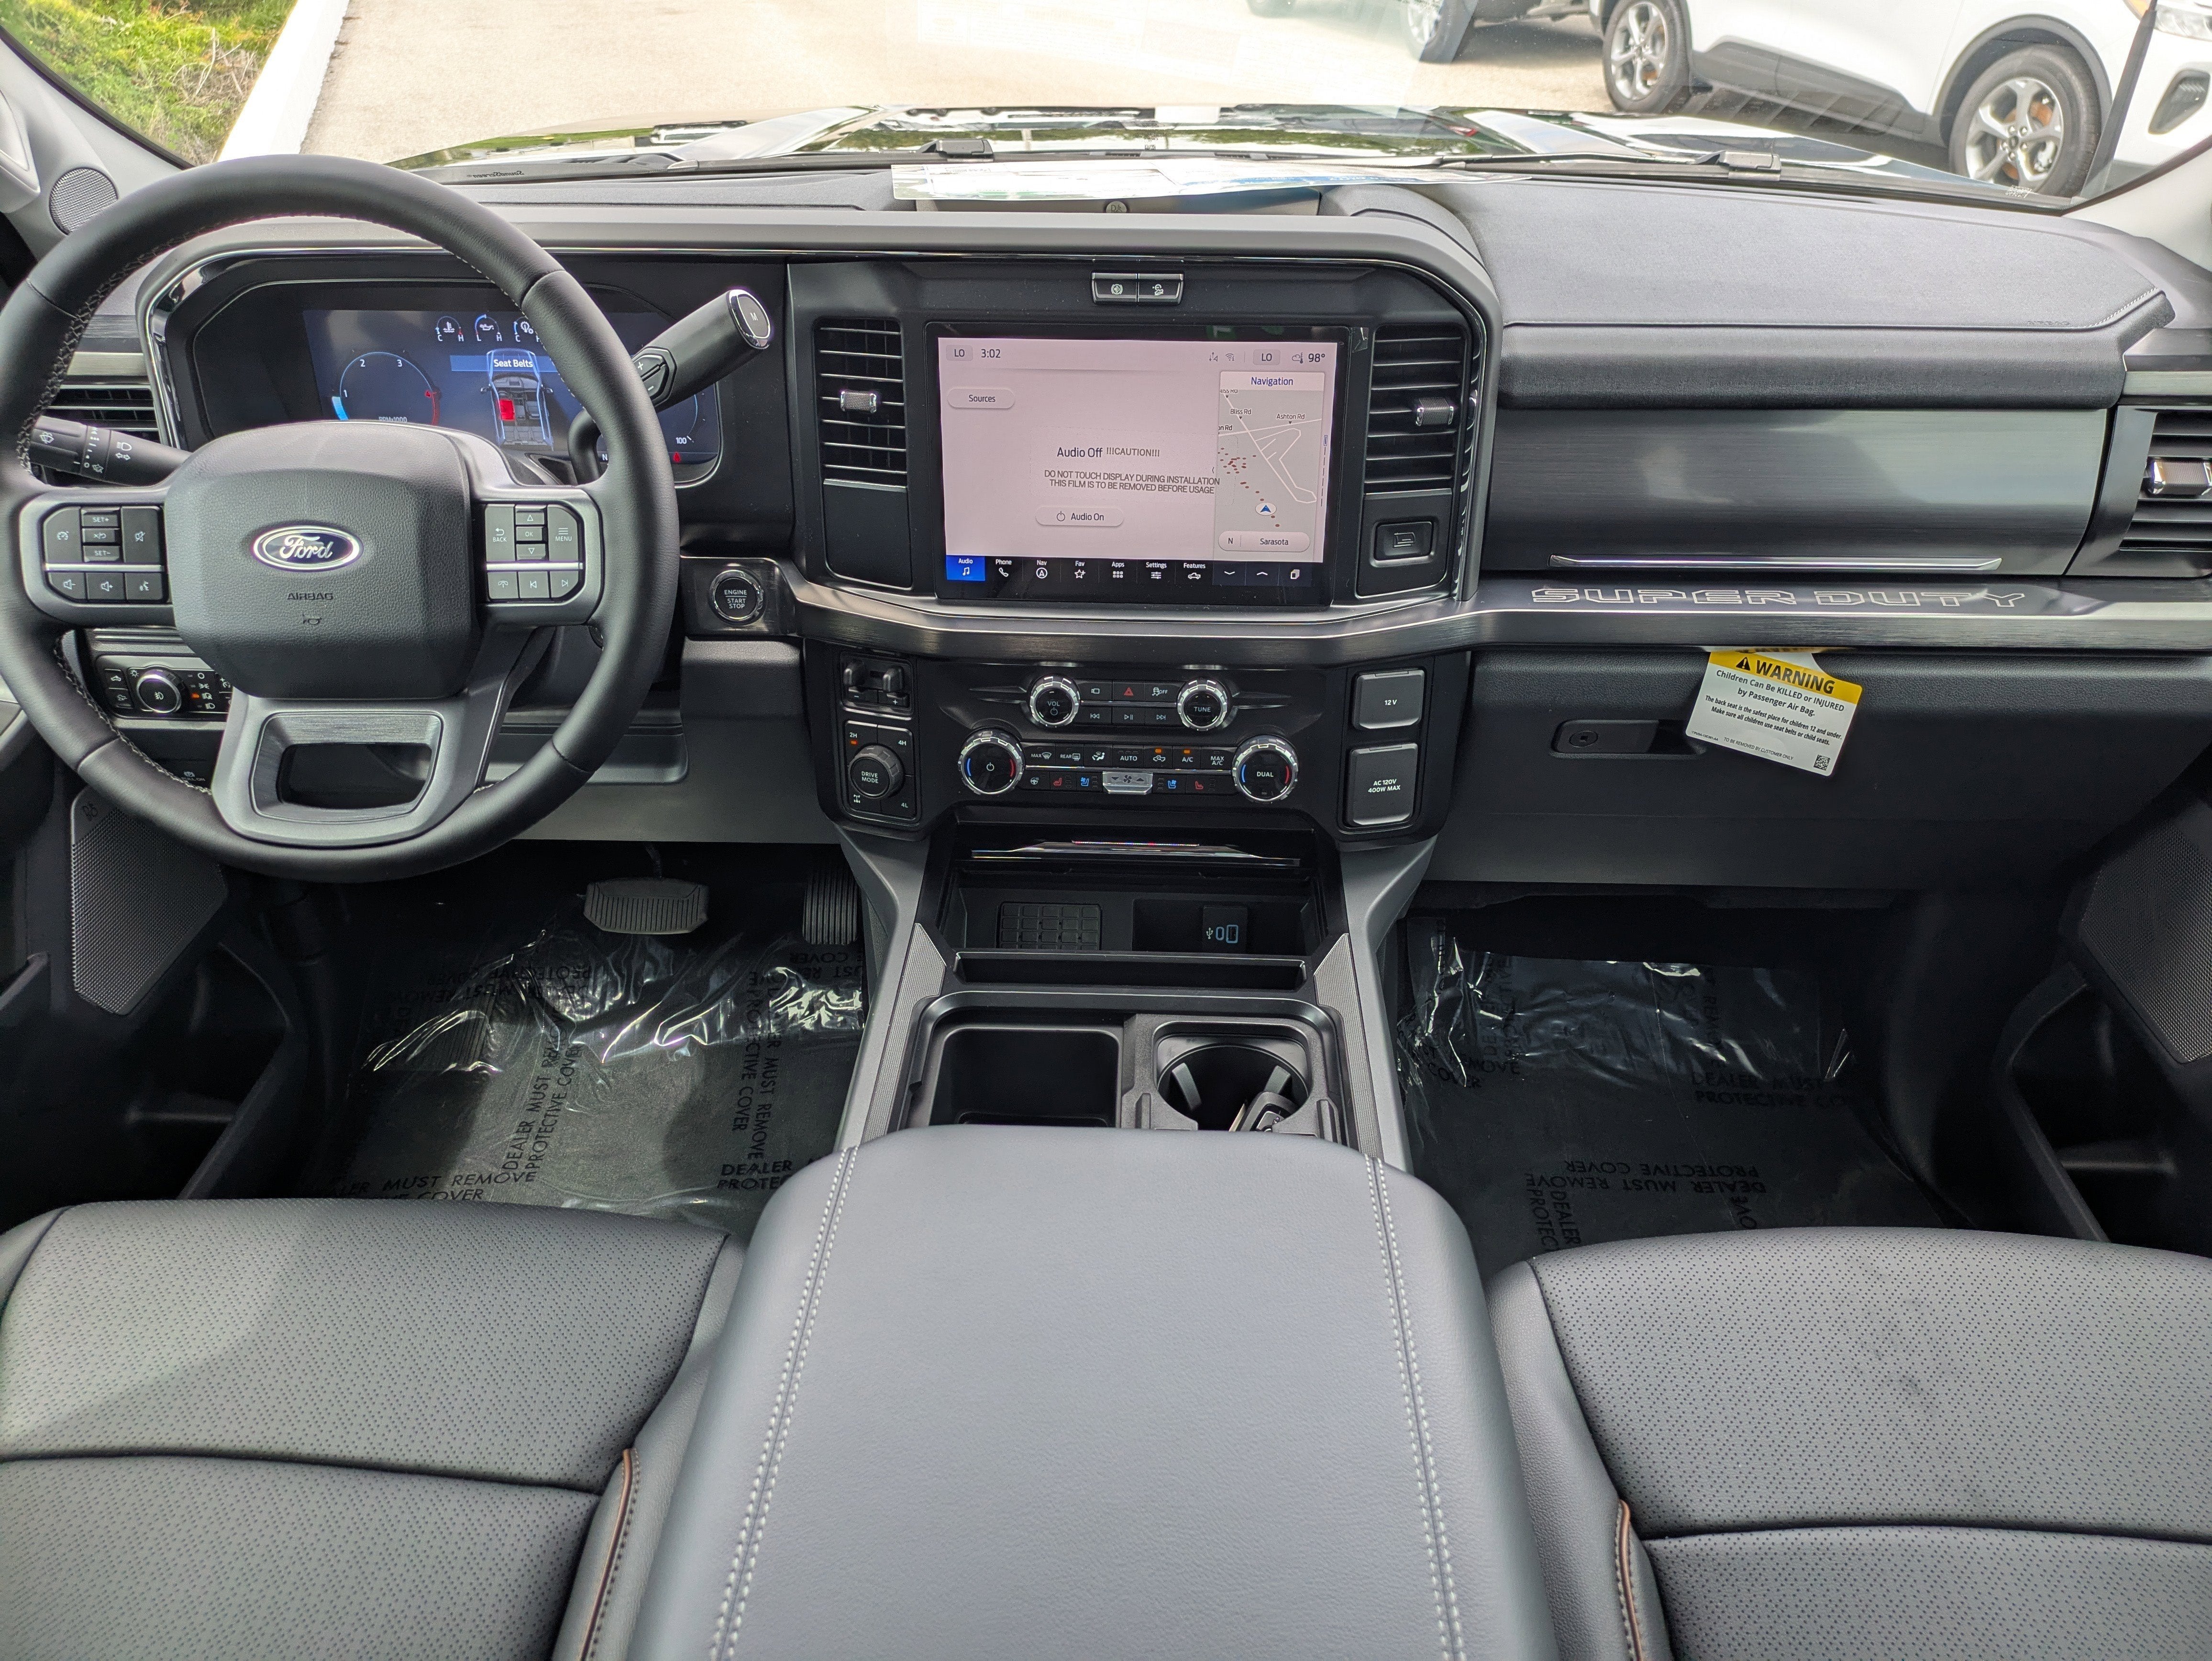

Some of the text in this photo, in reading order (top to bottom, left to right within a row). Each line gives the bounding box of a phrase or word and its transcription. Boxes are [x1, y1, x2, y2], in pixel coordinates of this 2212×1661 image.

[750, 312, 758, 321] M
[954, 349, 965, 357] LO
[981, 349, 1001, 358] 3:02
[1261, 354, 1272, 362] LO
[1308, 353, 1326, 363] 98°
[494, 359, 533, 367] Seat Belts
[1251, 377, 1294, 387] Navigation
[1057, 447, 1103, 458] Audio Off
[1106, 447, 1160, 457] !!!CAUTION!!!
[1057, 470, 1073, 478] NOT
[1074, 471, 1101, 480] TOUCH
[1103, 472, 1135, 481] DISPLAY
[1136, 474, 1165, 483] DURING
[1167, 476, 1220, 485] INSTALLATION
[1050, 479, 1066, 487] THIS
[1068, 480, 1086, 488] FILM
[1119, 482, 1156, 491] REMOVED
[1158, 484, 1188, 493] BEFORE
[1189, 486, 1215, 494] USAGE
[1071, 512, 1104, 521] Audio On
[280, 535, 334, 559] Ford
[1260, 538, 1289, 546] Sarasota
[287, 592, 333, 600] AIRBAG
[1531, 588, 2025, 608] SUPER DUTY
[1756, 660, 1835, 694] WARNING
[1716, 670, 1748, 684] Children
[1750, 679, 1764, 689] Can
[1765, 684, 1775, 692] Be
[1777, 687, 1803, 699] KILLED
[1814, 697, 1845, 711] INJURED
[1737, 687, 1815, 717] by Passenger Air Bag.
[1711, 706, 1725, 715] Make
[1744, 717, 1764, 726] children
[1785, 727, 1797, 736] belts
[1816, 737, 1830, 745] seats.
[1714, 698, 1726, 706] back
[1752, 709, 1767, 718] safest
[1767, 714, 1781, 722] place
[1789, 720, 1809, 730] children
[1826, 731, 1842, 740] under.
[1736, 741, 1755, 749] REMOVED
[1761, 748, 1782, 757] CUSTOMER
[760, 1058, 780, 1096] MUST
[732, 1086, 754, 1132] COVER
[502, 1076, 552, 1170] DEALER MUST
[525, 1092, 567, 1169] PROTECTIVE
[747, 1101, 773, 1160] REMOVE
[720, 1160, 793, 1177] DEALER
[1564, 1160, 1759, 1178] PROTECTIVE COVER
[383, 1175, 442, 1191] MUST
[452, 1171, 537, 1187] REMOVE
[1526, 1173, 1767, 1194] DEALER MUST REMOVE
[1549, 1189, 1582, 1247] DEALER
